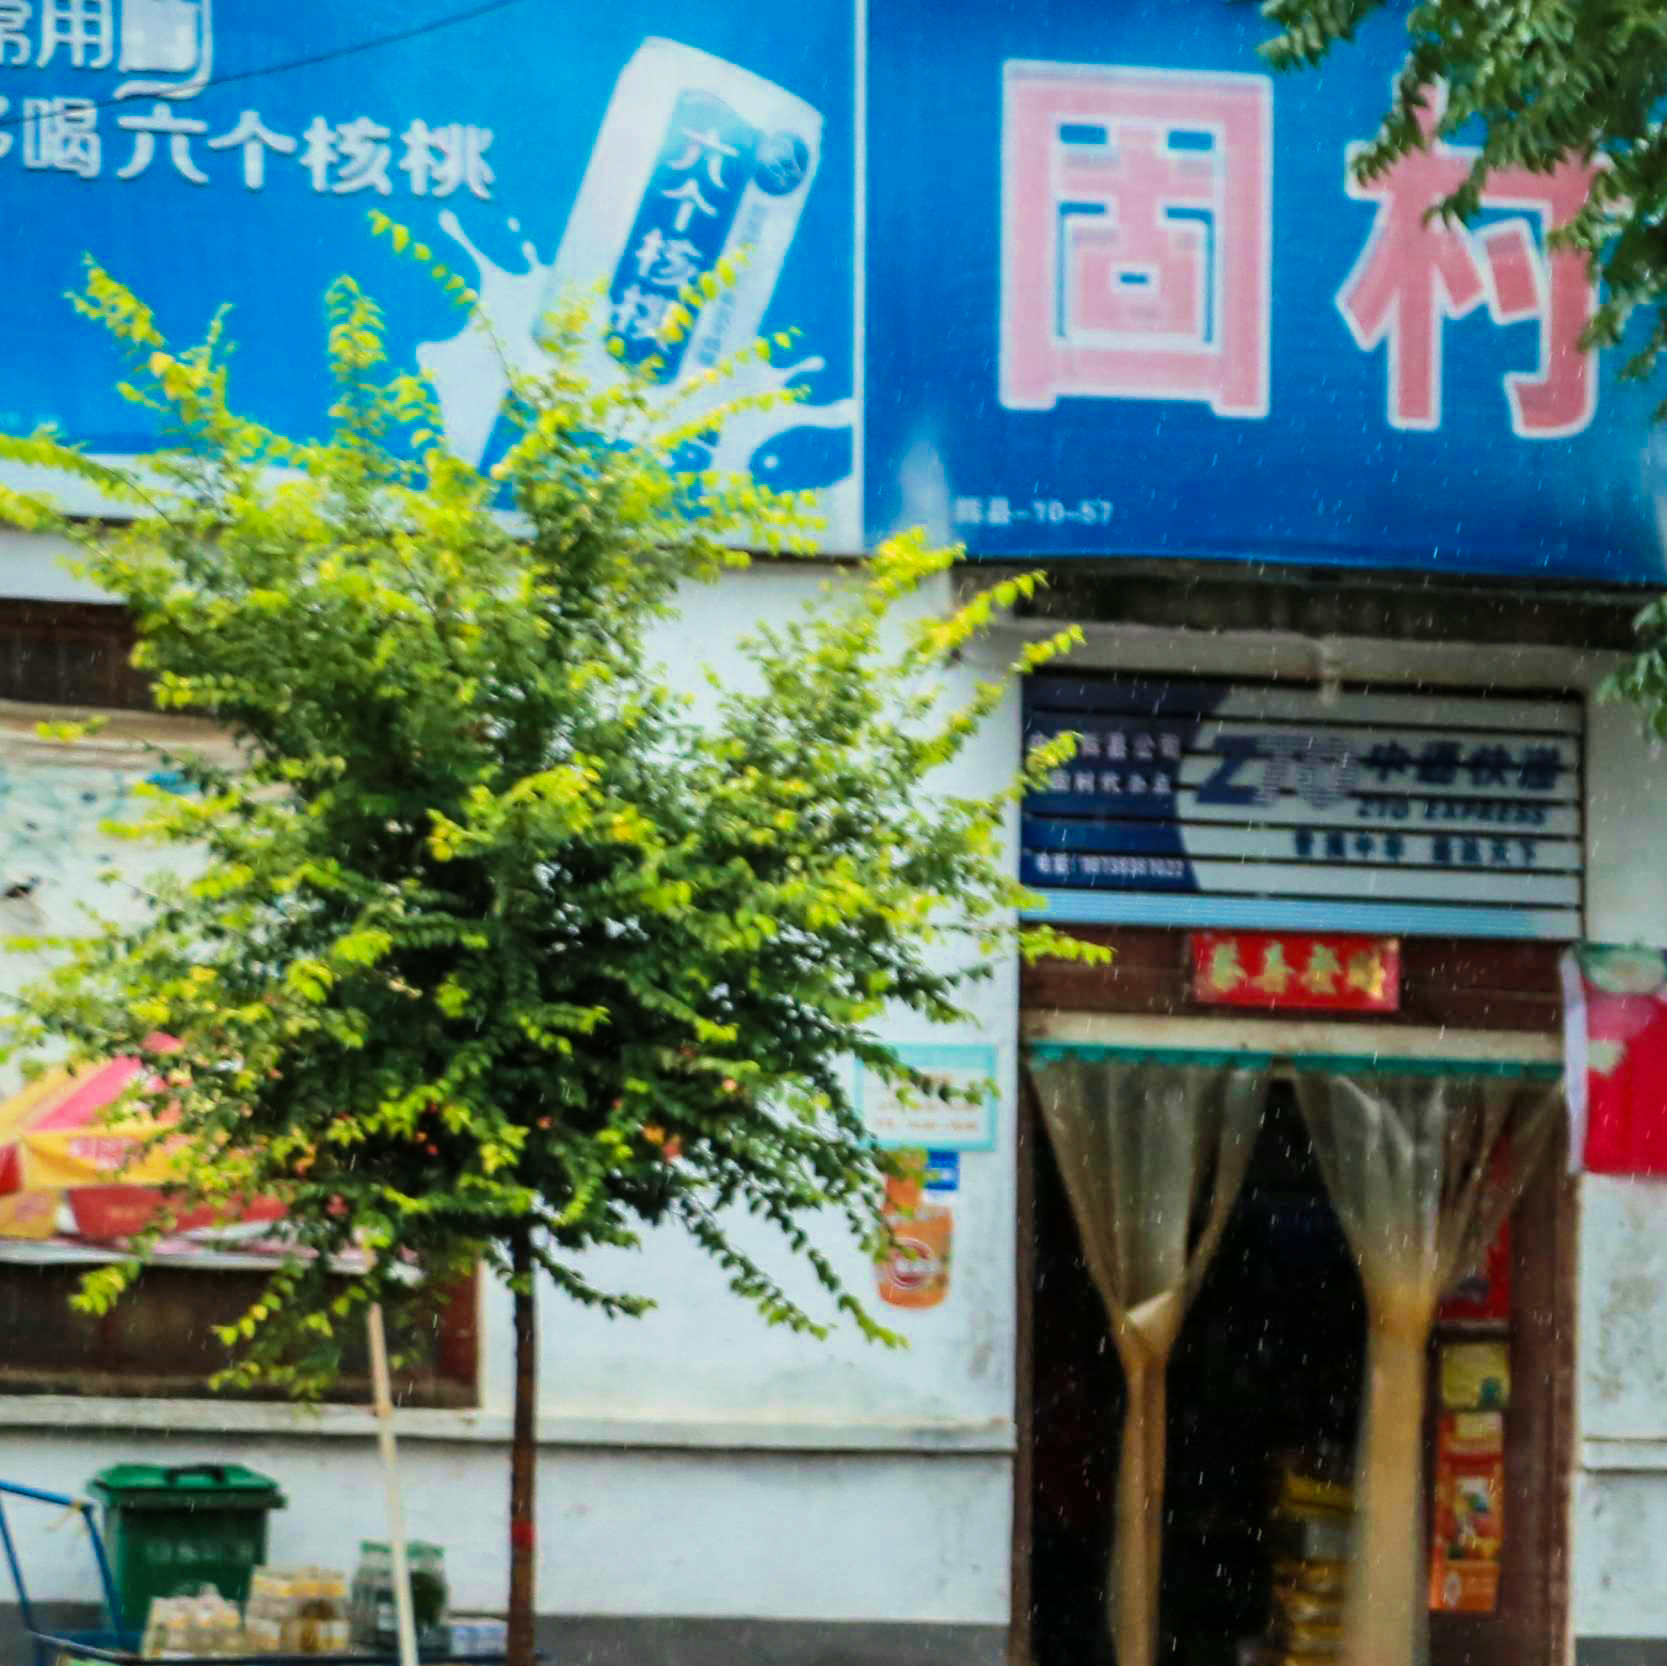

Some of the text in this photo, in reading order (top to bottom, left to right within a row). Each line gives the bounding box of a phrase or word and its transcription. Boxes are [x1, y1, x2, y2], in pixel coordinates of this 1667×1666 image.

[0, 96, 495, 200] 喝六个核桃
